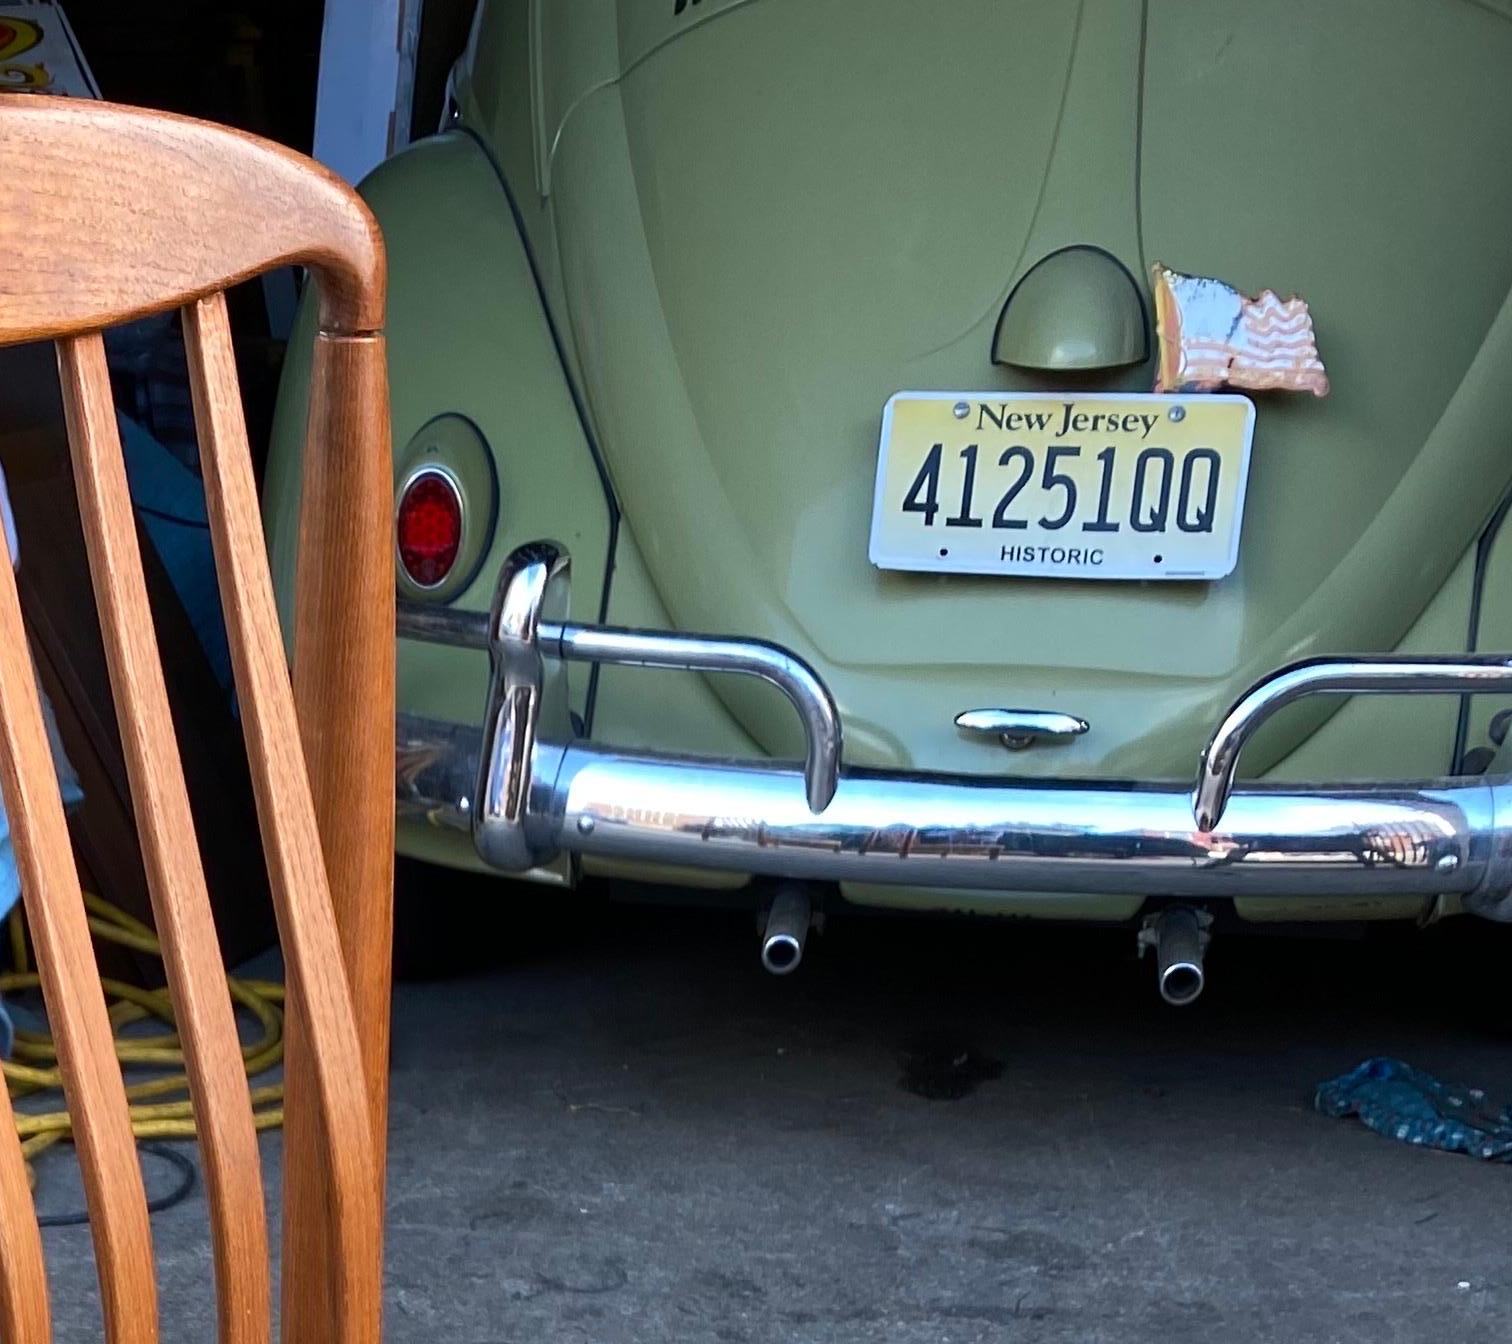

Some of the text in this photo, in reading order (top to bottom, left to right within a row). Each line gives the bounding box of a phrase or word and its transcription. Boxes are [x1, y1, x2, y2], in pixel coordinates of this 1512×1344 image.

[976, 402, 1160, 439] New Jersey
[902, 443, 1222, 533] 41251QQ
[1000, 545, 1104, 565] HISTORIC
